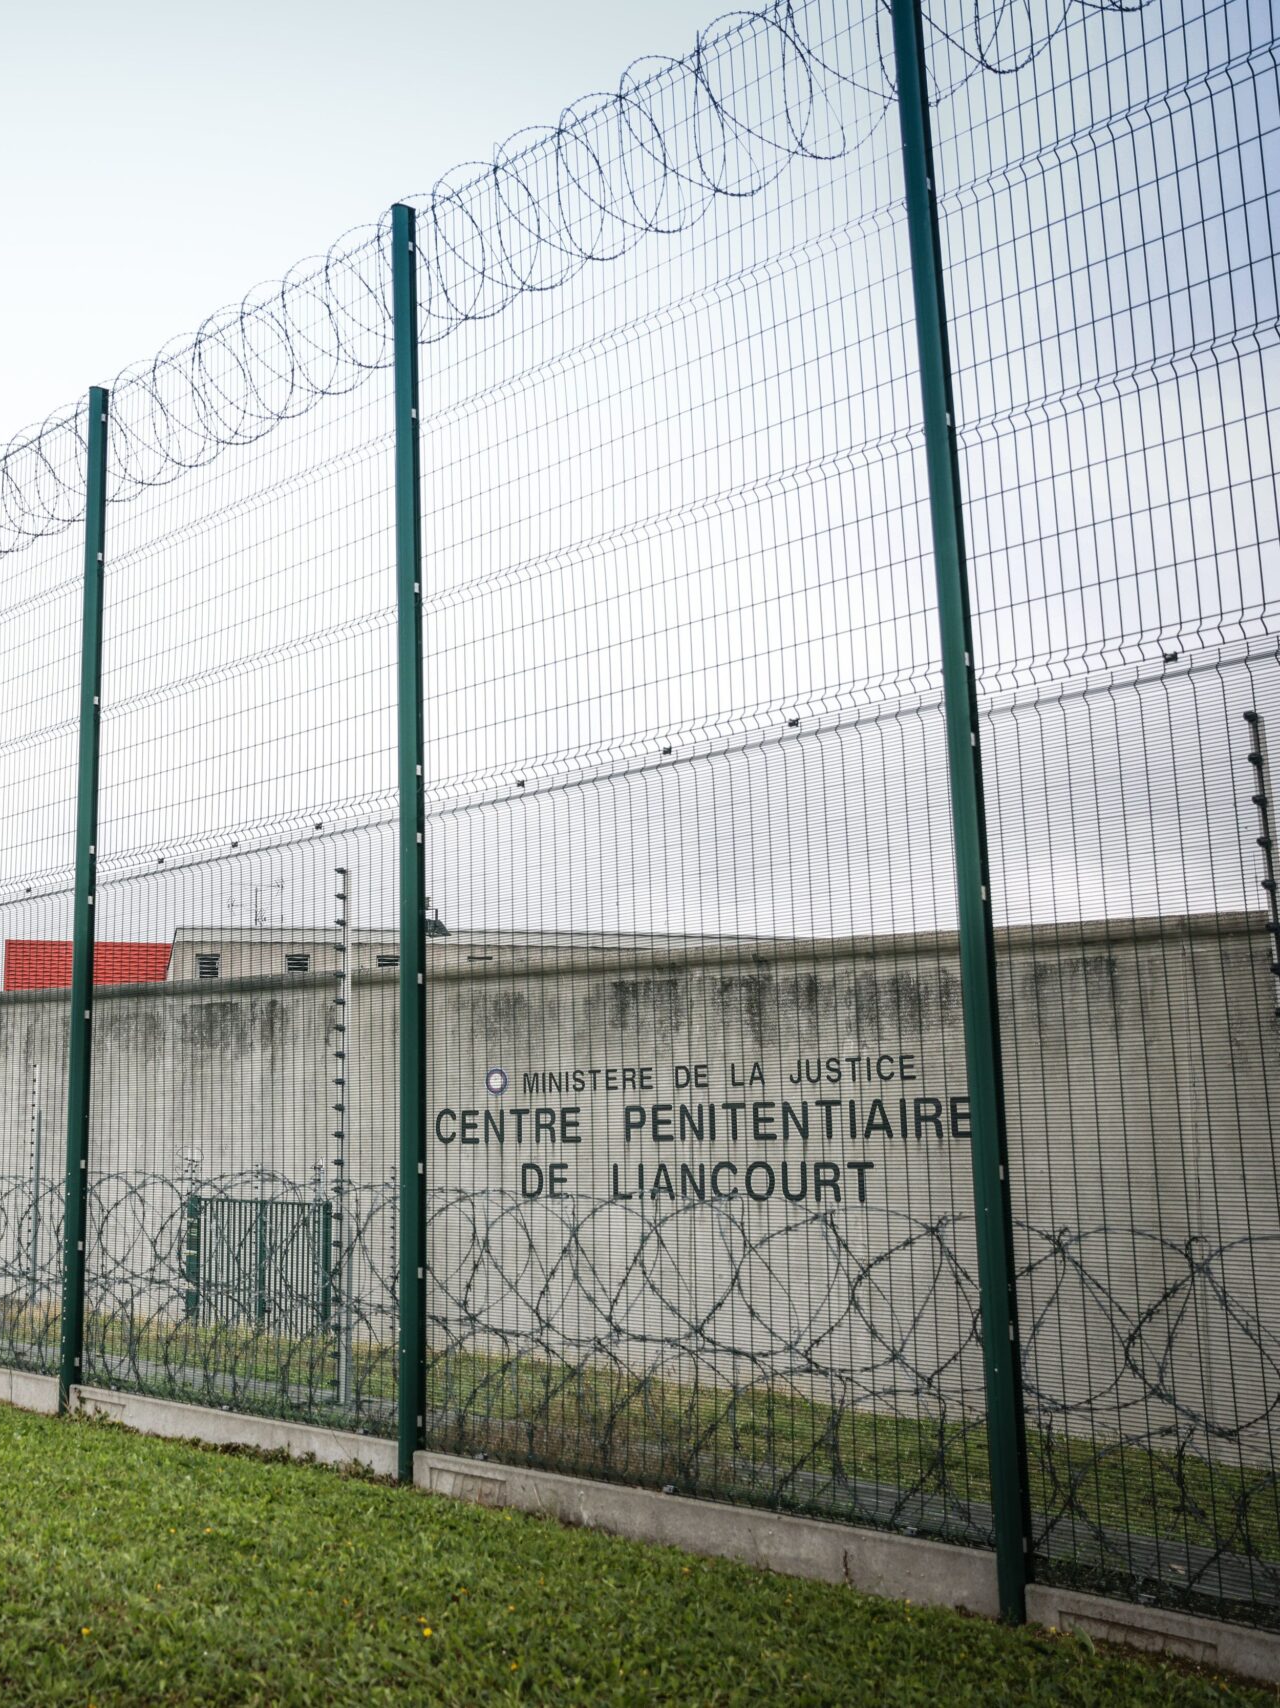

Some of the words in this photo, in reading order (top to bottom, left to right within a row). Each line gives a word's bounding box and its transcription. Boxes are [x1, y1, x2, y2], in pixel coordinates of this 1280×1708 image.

[522, 1067, 654, 1094] MINISTERE
[674, 1064, 710, 1089] DE
[730, 1061, 766, 1087] LA
[789, 1054, 917, 1084] JUSTICE
[435, 1107, 582, 1145] CENTRE
[624, 1097, 972, 1143] PENITENTIAIRE
[521, 1162, 569, 1200] DE
[612, 1161, 875, 1204] LIANCOURT
